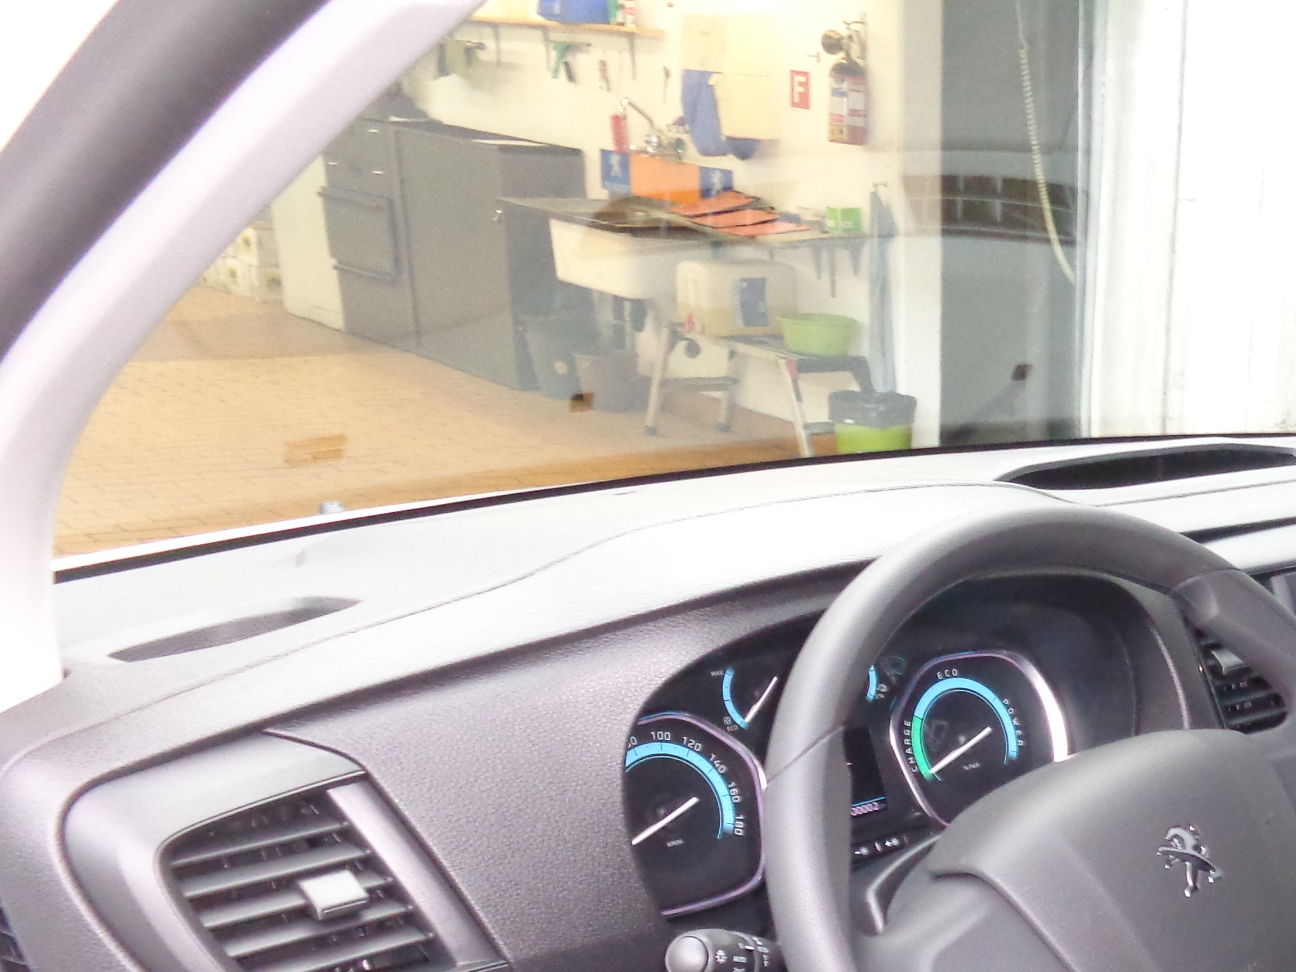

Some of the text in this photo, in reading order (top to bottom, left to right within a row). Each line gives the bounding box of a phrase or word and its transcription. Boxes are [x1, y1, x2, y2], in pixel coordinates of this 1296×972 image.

[793, 75, 807, 103] F
[937, 668, 958, 680] ECO
[1002, 698, 1025, 747] POWER
[650, 731, 671, 741] 100
[682, 736, 702, 752] 120
[903, 720, 918, 773] CHARGE
[708, 753, 726, 774] 140
[727, 781, 742, 803] 160
[734, 815, 745, 836] 180
